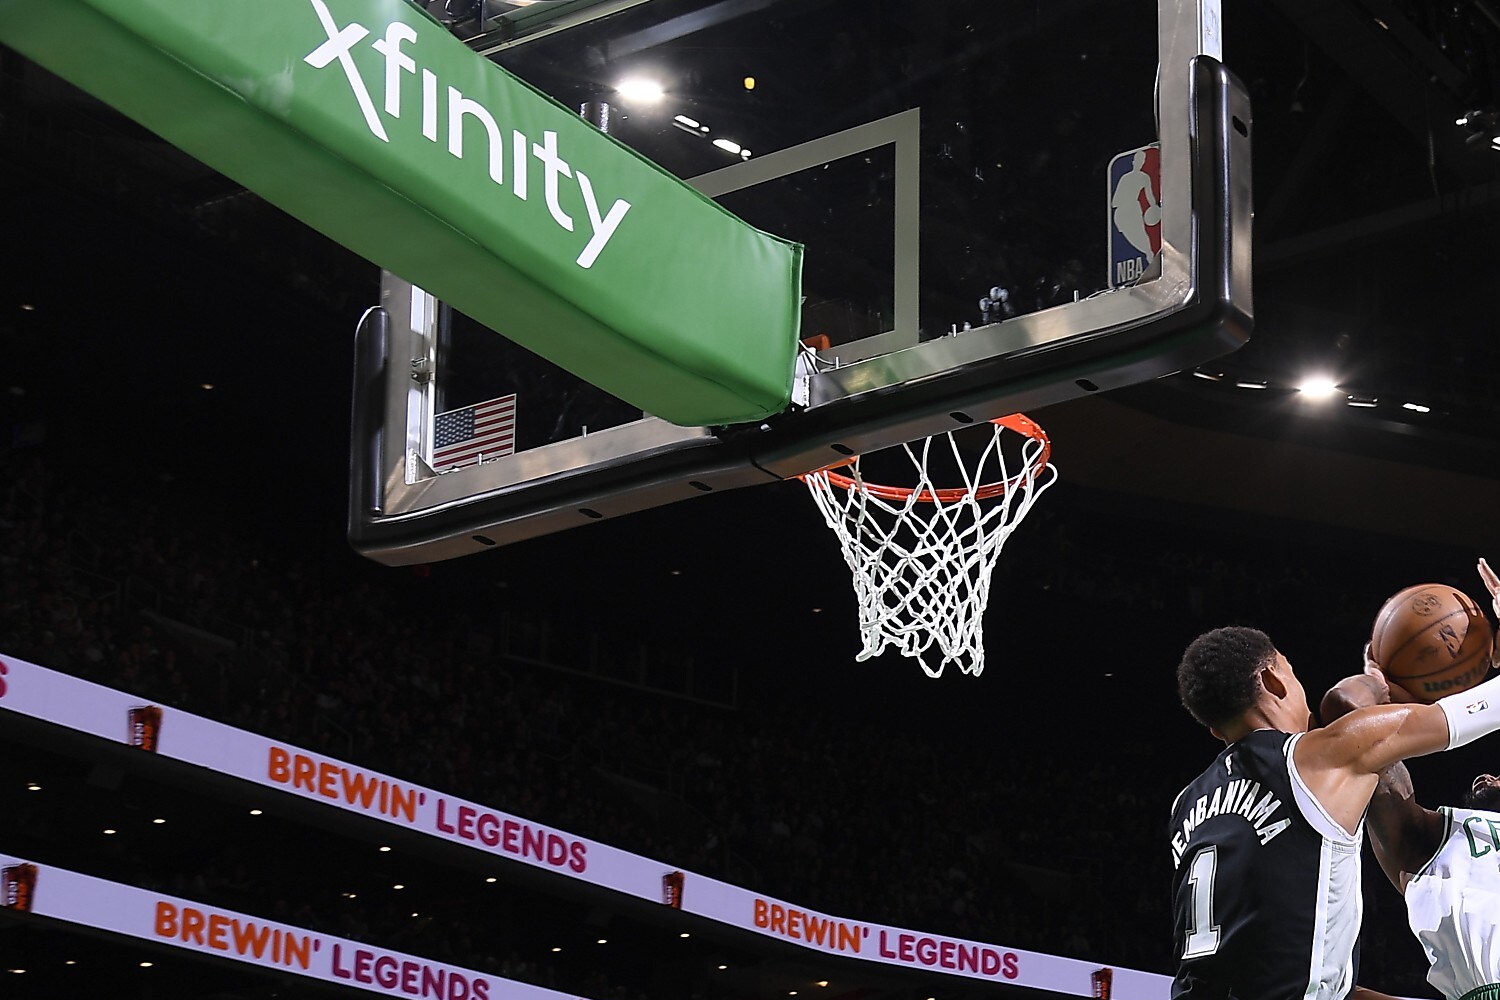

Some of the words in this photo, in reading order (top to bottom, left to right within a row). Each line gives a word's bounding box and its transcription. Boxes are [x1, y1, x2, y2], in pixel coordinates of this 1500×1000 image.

[303, 0, 632, 269] xfinity
[1116, 256, 1144, 284] NBA
[268, 746, 426, 823] BREWIN'
[436, 798, 587, 873] LEGENDS
[154, 900, 320, 970] BREWIN'
[753, 898, 869, 954] BREWIN'
[879, 929, 1019, 980] LEGENDS
[1181, 845, 1221, 959] 1
